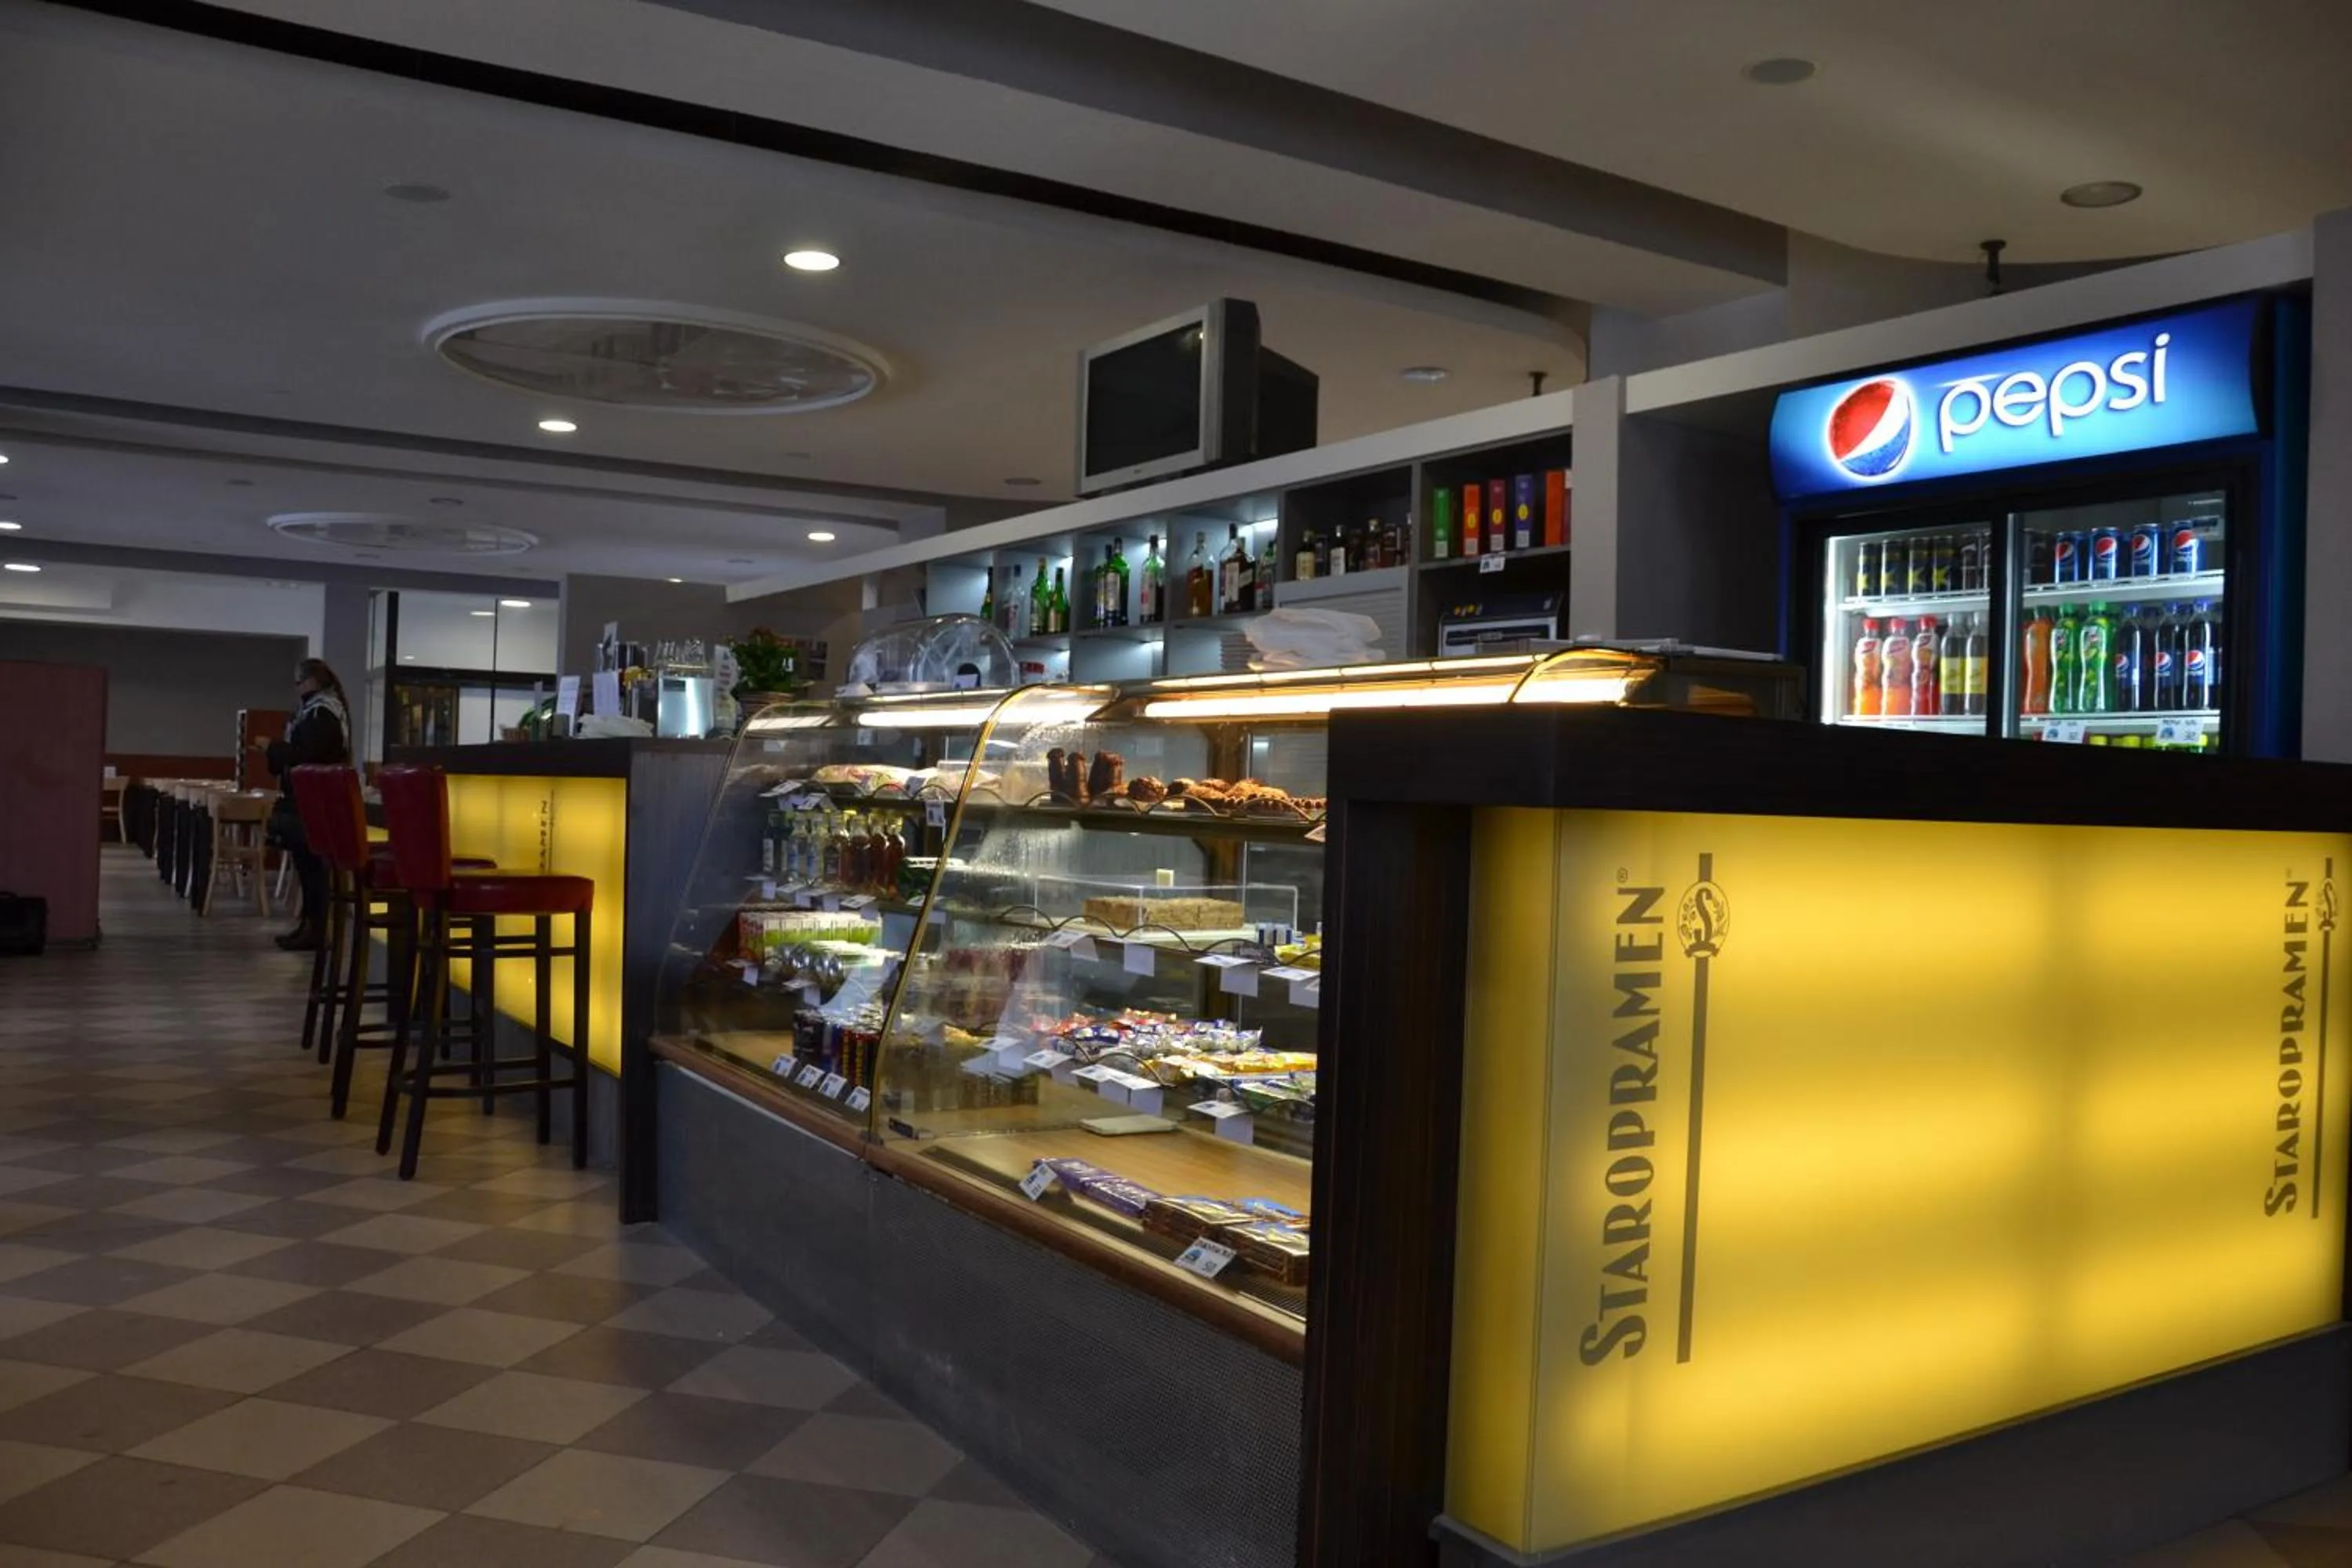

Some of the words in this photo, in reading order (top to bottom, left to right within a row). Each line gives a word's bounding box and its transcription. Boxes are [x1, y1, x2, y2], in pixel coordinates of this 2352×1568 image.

[1939, 332, 2170, 452] pepsi
[1580, 887, 1664, 1366] STAROPRAMEN
[2264, 881, 2309, 1218] STAROPRAMEN
